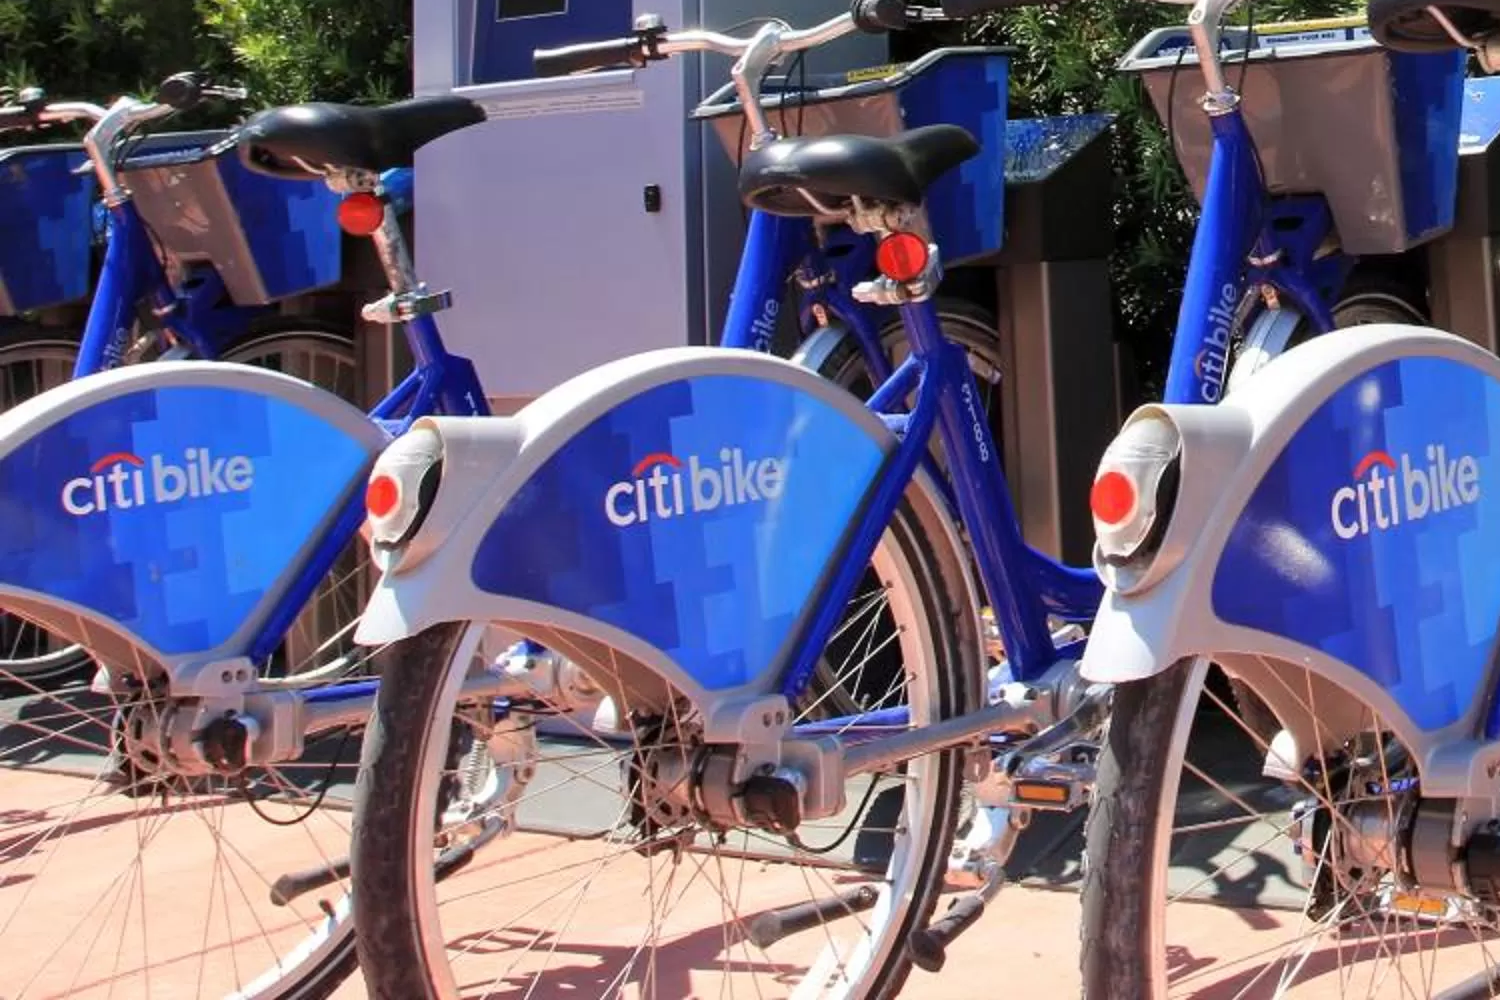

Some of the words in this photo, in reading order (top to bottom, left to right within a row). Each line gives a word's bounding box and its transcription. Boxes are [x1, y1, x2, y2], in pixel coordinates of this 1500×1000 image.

[1204, 283, 1237, 348] bike
[1200, 350, 1224, 402] citi
[62, 452, 145, 515] citi
[151, 447, 254, 503] bike
[605, 453, 685, 526] citi
[688, 447, 785, 511] bike
[1331, 451, 1399, 539] citi
[1401, 444, 1480, 520] bike
